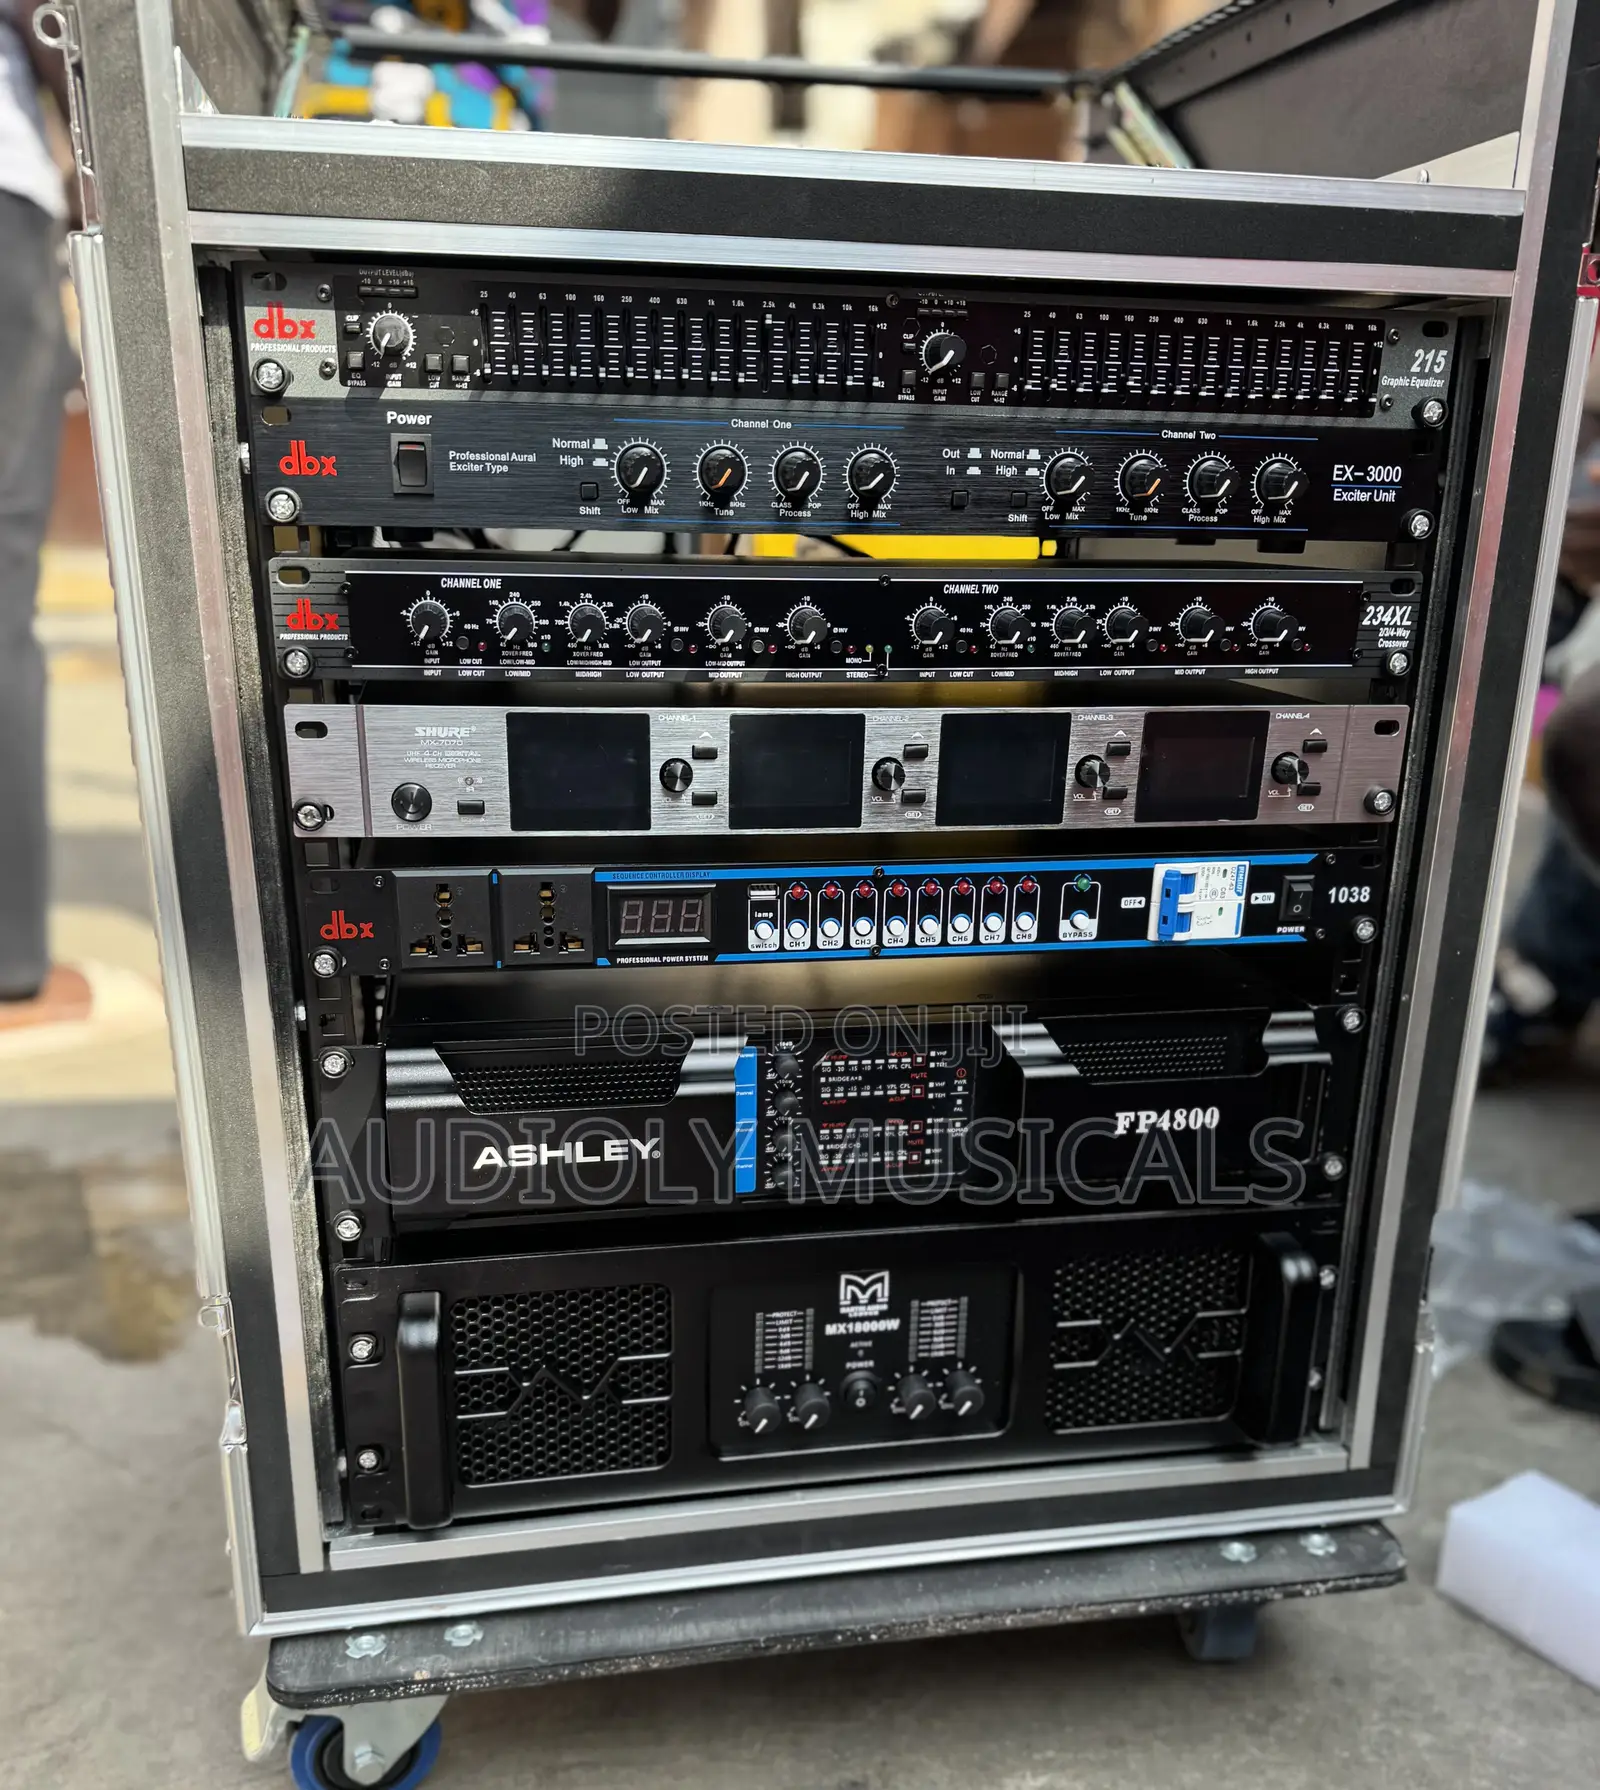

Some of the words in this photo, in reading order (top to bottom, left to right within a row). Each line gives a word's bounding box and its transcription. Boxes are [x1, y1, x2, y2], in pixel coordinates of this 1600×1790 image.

[508, 291, 516, 299] 40
[789, 302, 796, 310] 4k
[253, 302, 315, 338] dbx
[250, 343, 300, 352] PROFESSIONAL
[301, 345, 336, 353] PRODUCTS
[1410, 349, 1448, 373] 215
[1381, 376, 1409, 388] Graphic
[1410, 376, 1444, 388] Equalizer
[386, 411, 432, 425] Power
[731, 419, 769, 428] Channel
[773, 420, 792, 429] One
[1161, 430, 1196, 439] Channel
[1200, 431, 1216, 440] Two
[552, 438, 590, 449] Normal
[279, 440, 337, 476] dbx
[449, 451, 510, 462] Professional
[511, 452, 536, 462] Aural
[942, 449, 960, 459] Out
[990, 449, 1024, 459] Normal
[559, 455, 584, 467] High
[450, 462, 483, 472] Exciter
[485, 463, 508, 474] Type
[946, 467, 955, 475] In
[996, 466, 1018, 477] High
[1333, 488, 1373, 502] Exciter
[1374, 491, 1396, 502] Unit
[579, 506, 601, 515] Shift
[621, 505, 638, 513] Low
[644, 506, 659, 514] Mix
[714, 508, 734, 516] Tune
[779, 509, 812, 518] Process
[850, 510, 869, 519] High
[1008, 514, 1028, 522] Shift
[1044, 512, 1060, 520] Low
[1129, 513, 1147, 521] Tune
[1188, 514, 1218, 523] Process
[1253, 515, 1270, 524] High
[440, 578, 481, 589] CHANNEL
[484, 579, 501, 589] ONE
[943, 584, 980, 594] CHANNEL
[981, 585, 999, 594] TWO
[286, 598, 339, 630] dbx
[1361, 605, 1412, 626] 234XL
[1379, 627, 1410, 639] 2/3/4-Way
[1378, 638, 1409, 648] Crossover
[612, 872, 644, 880] SEQUENCE
[685, 871, 710, 879] DISPLAY
[1261, 894, 1272, 902] ON
[1328, 887, 1371, 904] 1038
[1124, 898, 1137, 907] OFF
[755, 911, 773, 919] lamp
[320, 910, 375, 940] dbx
[617, 956, 661, 964] PROFESSIONAL
[1114, 1107, 1220, 1136] FP4800
[825, 1319, 900, 1336] MX18000W
[846, 1361, 874, 1369] POWER
